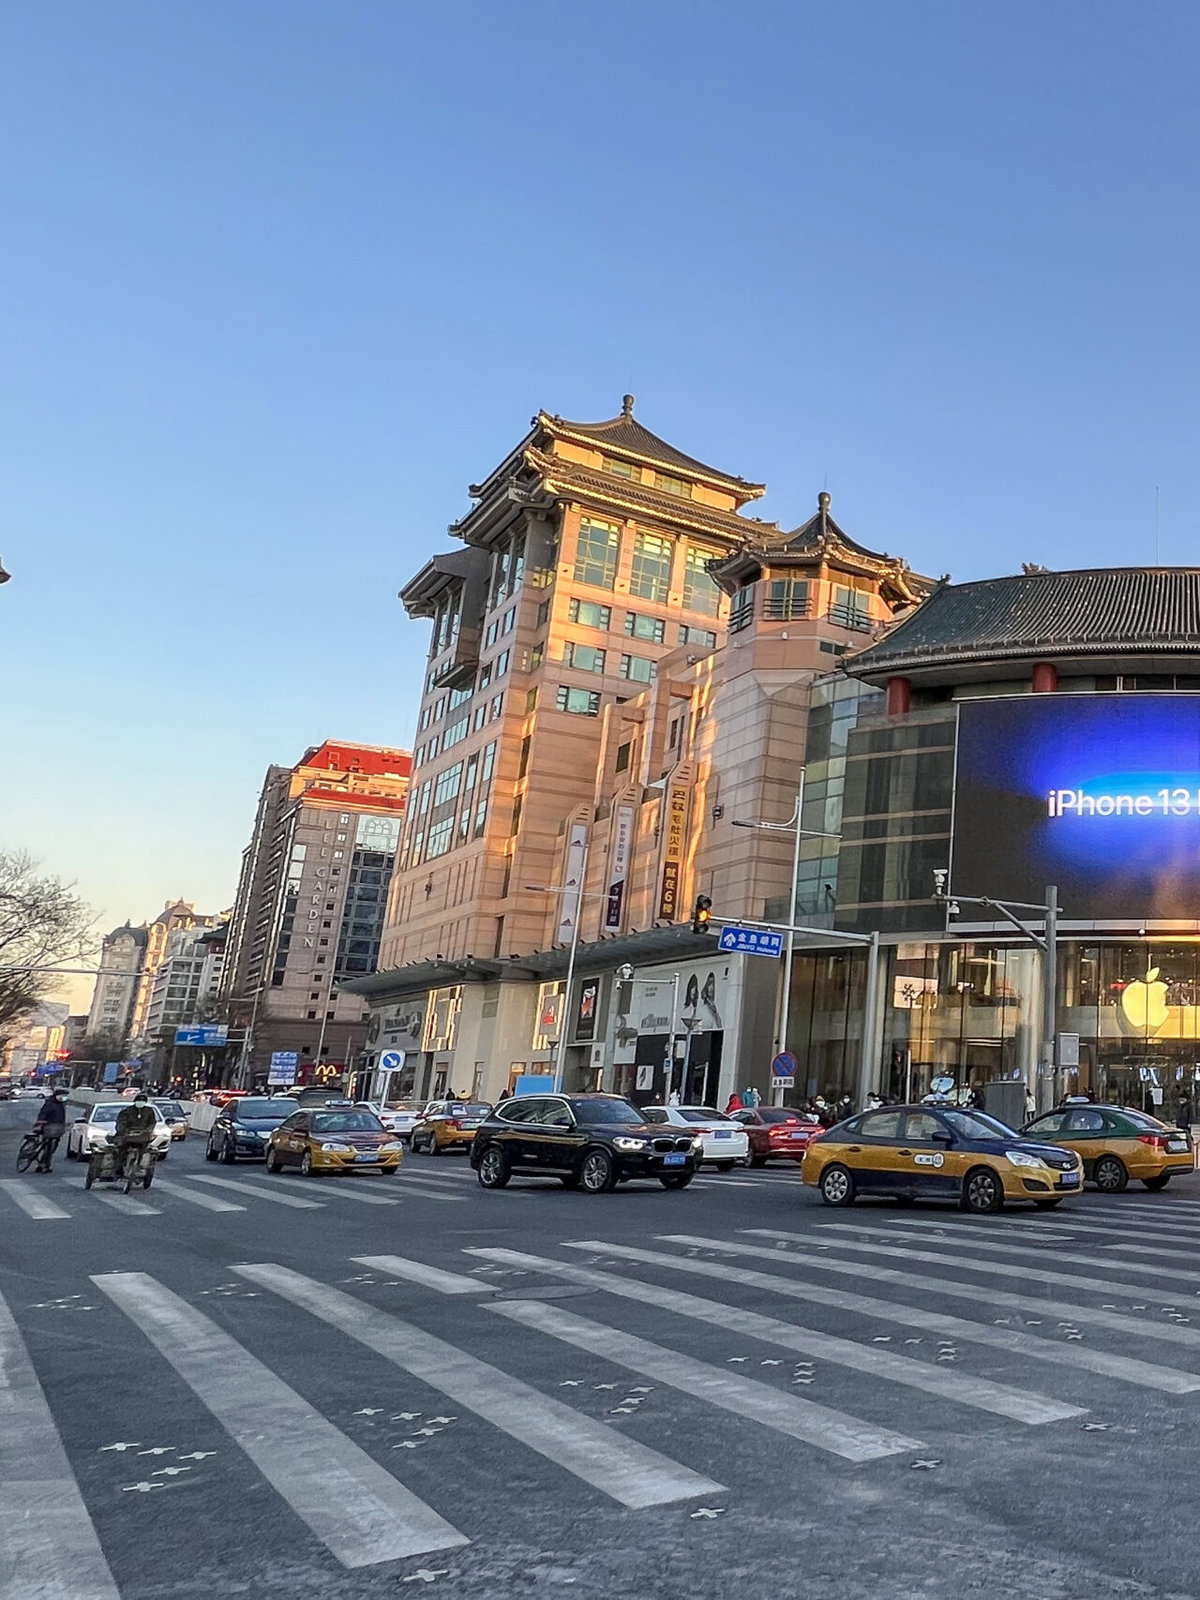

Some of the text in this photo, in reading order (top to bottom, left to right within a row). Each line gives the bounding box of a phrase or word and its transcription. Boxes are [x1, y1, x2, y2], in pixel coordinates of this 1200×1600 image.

[1048, 789, 1152, 817] iPhone
[1158, 788, 1190, 816] 13
[321, 819, 332, 858] LEE
[303, 867, 327, 948] GARDEN
